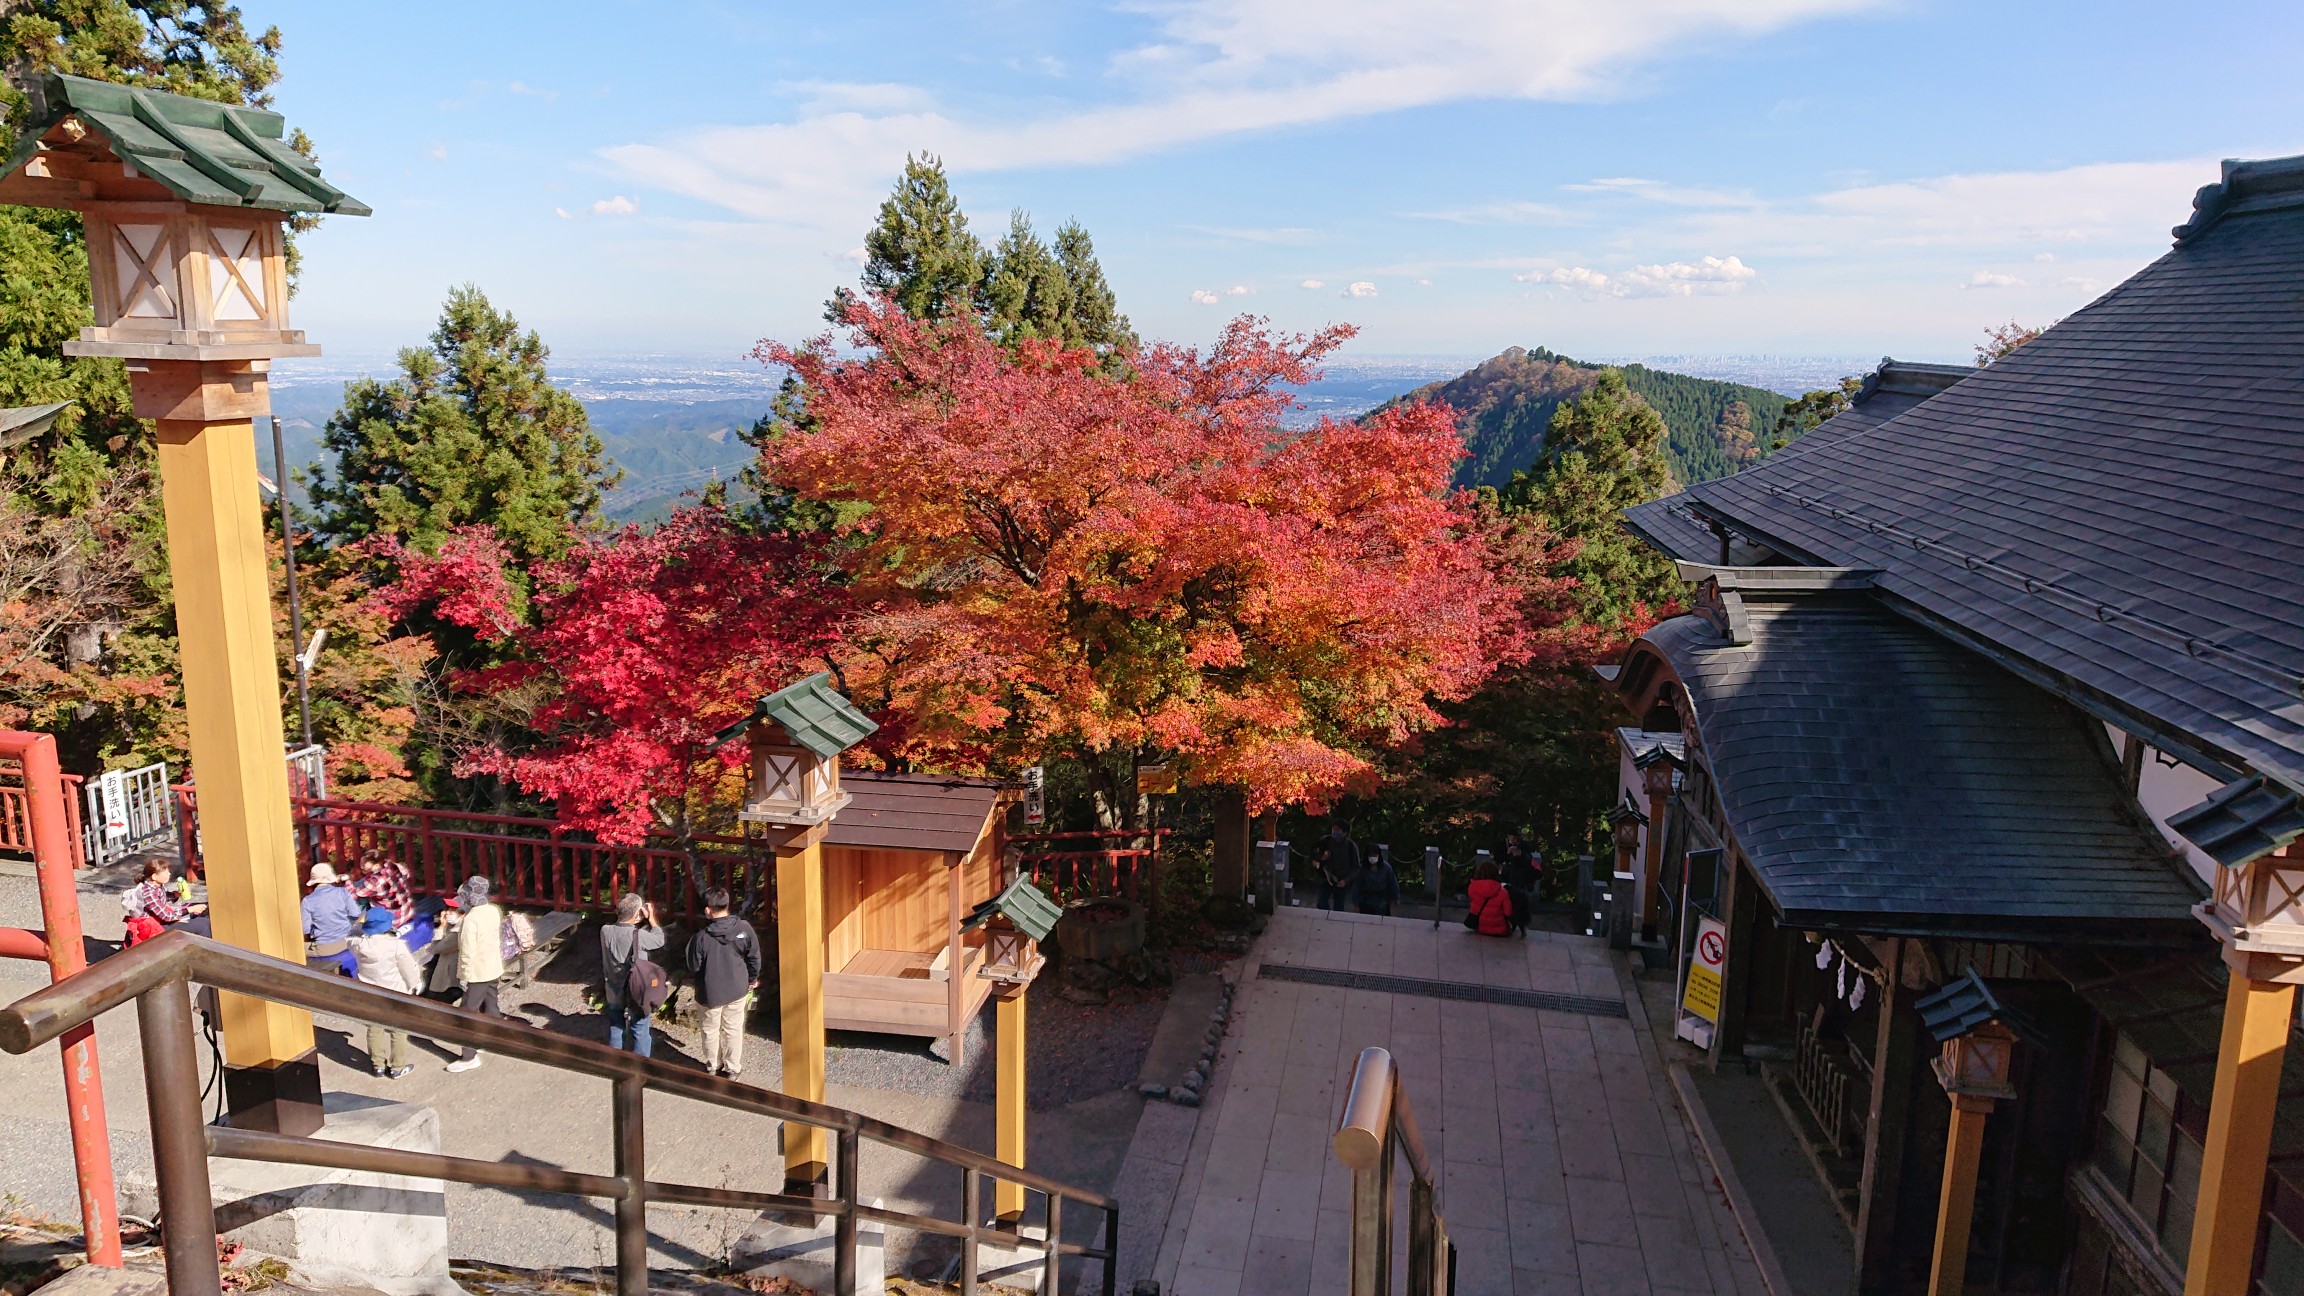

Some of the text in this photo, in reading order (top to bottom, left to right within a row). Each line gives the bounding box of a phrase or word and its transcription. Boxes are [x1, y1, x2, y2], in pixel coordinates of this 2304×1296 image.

[106, 776, 121, 820] お手洗い
[1028, 769, 1040, 812] お手洗い
